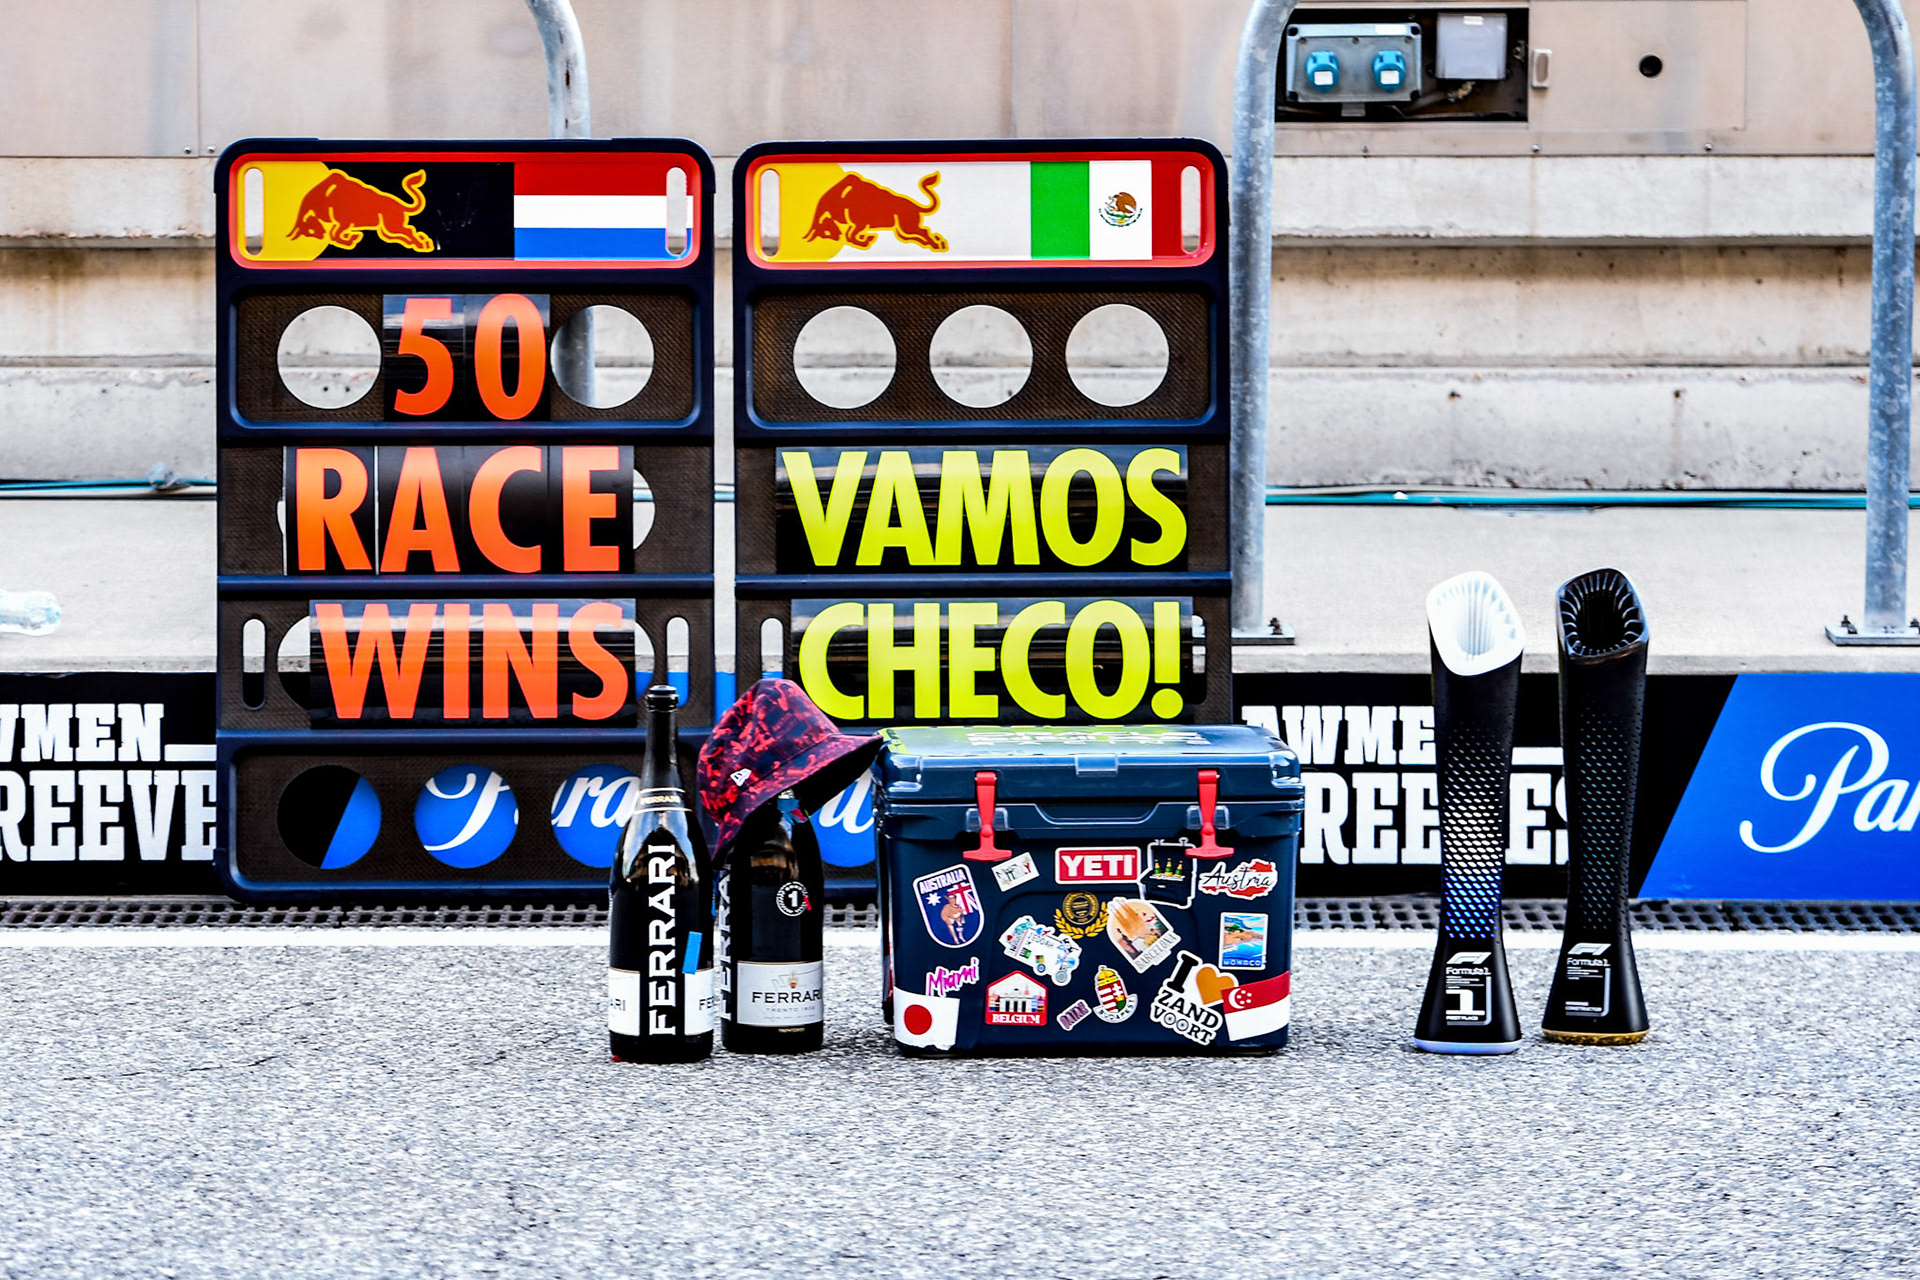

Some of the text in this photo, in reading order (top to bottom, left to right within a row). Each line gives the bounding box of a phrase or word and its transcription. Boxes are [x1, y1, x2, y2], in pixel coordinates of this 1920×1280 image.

[394, 293, 546, 420] 50
[296, 446, 620, 573] RACE
[781, 448, 1187, 566] VAMOS
[315, 602, 629, 720] WINS
[799, 600, 1184, 720] CHECO!
[919, 868, 967, 894] AUSTRALIA
[1061, 856, 1135, 877] YETI
[1203, 863, 1273, 890] Austria
[648, 844, 676, 1036] FERRARI
[928, 957, 979, 995] Miami
[1167, 954, 1199, 994] I
[992, 1013, 1040, 1024] BELGIUM
[1153, 1005, 1216, 1043] VOORT
[1156, 989, 1219, 1029] ZAND
